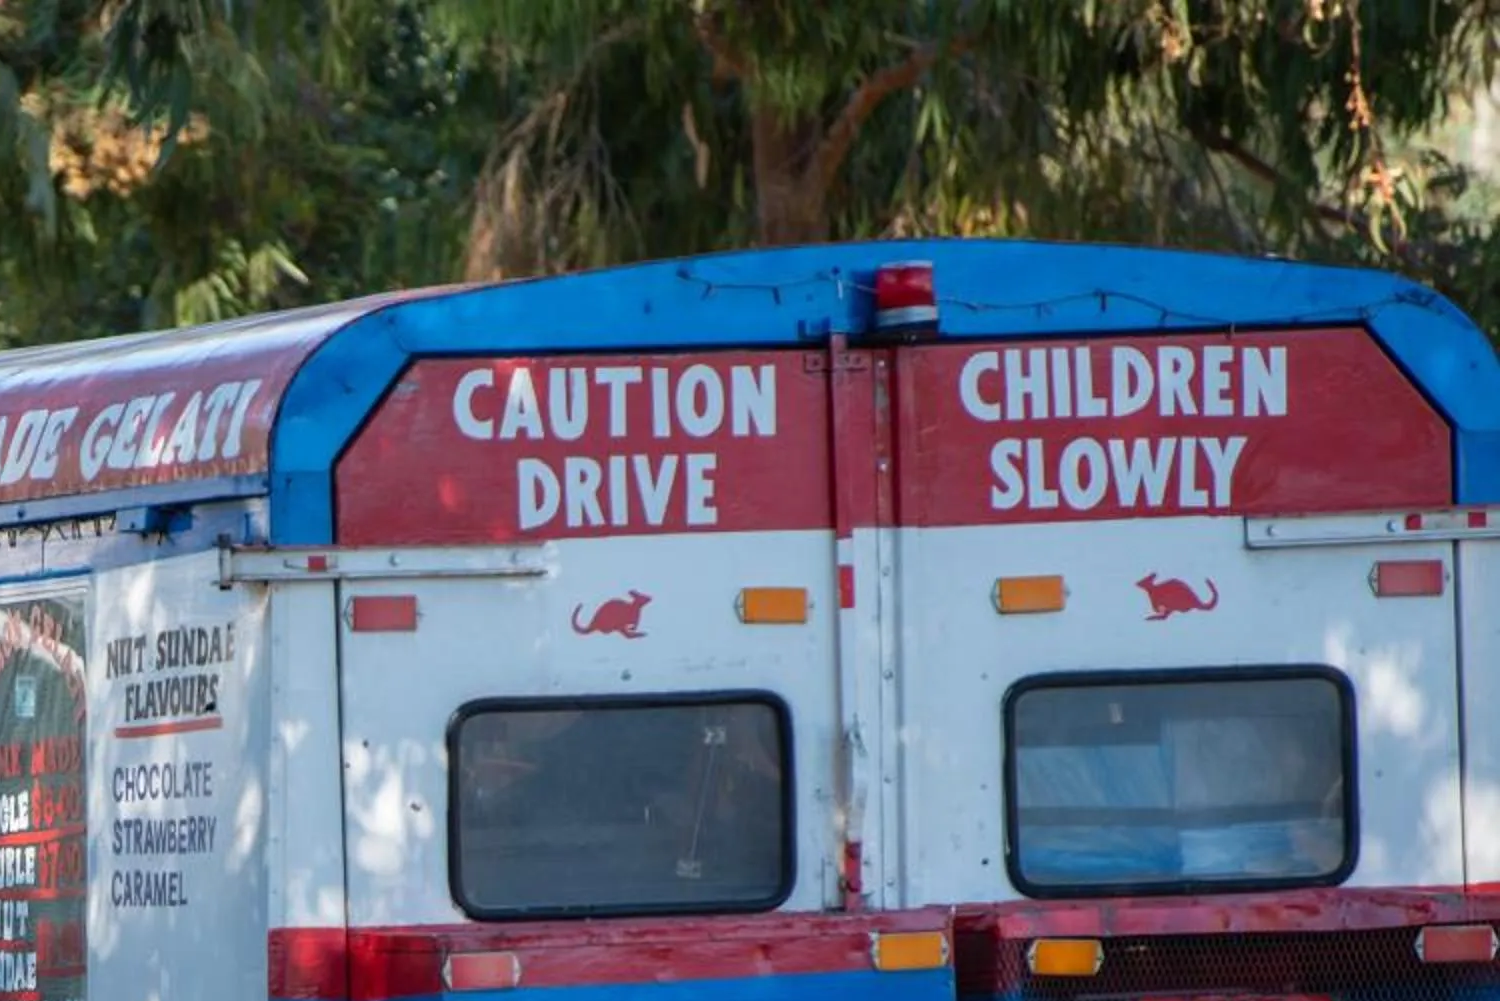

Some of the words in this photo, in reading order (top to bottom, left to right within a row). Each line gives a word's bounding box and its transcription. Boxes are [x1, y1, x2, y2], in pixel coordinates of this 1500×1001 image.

[453, 364, 777, 440] CAUTION
[959, 345, 1288, 421] CHILDREN
[80, 379, 263, 480] GELATI
[516, 453, 718, 530] DRIVE
[990, 436, 1248, 511] SLOWLY
[106, 634, 147, 680] NUT
[154, 621, 235, 672] SUNDAE
[124, 673, 220, 723] FLAVOURS
[112, 761, 214, 803] CHOCOLATE
[111, 815, 217, 856] STRAWBERRY
[110, 868, 188, 908] CARAMEL
